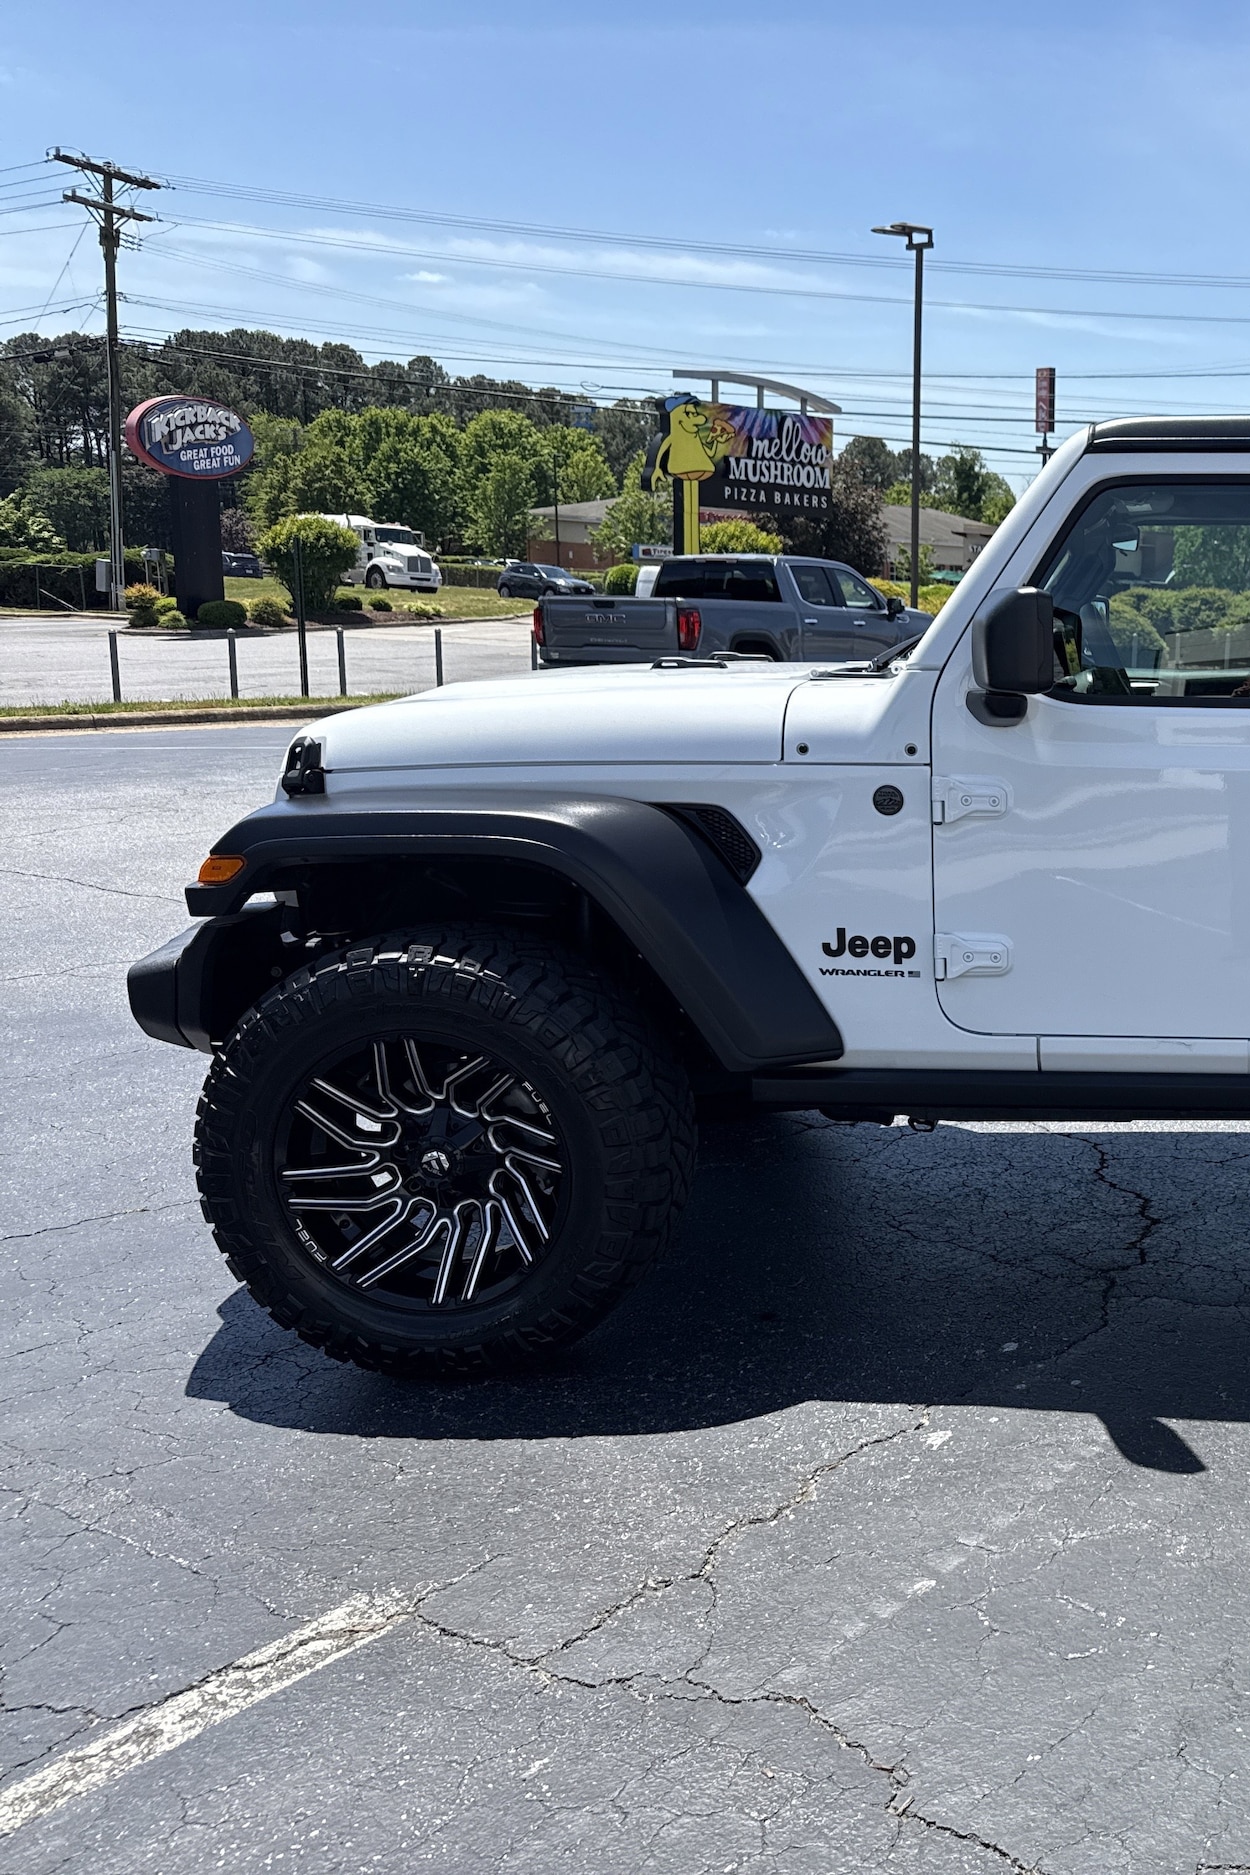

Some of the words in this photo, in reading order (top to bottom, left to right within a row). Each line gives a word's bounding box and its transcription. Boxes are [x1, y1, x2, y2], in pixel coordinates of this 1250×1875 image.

[151, 405, 241, 442] KICKBACK
[172, 424, 227, 451] JACK'S
[180, 447, 208, 461] GREAT
[211, 444, 234, 457] FOOD
[193, 457, 221, 471] GREAT
[223, 454, 241, 467] FUN
[728, 457, 831, 490] MUSHROOM
[724, 486, 767, 503] PIZZA
[774, 491, 828, 509] BAKERS
[968, 544, 983, 553] STA
[585, 613, 626, 624] GMC
[821, 927, 916, 965] Jeep
[818, 967, 905, 978] WRANGLER
[521, 1080, 552, 1126] FUEL
[295, 1218, 327, 1263] FUEL
